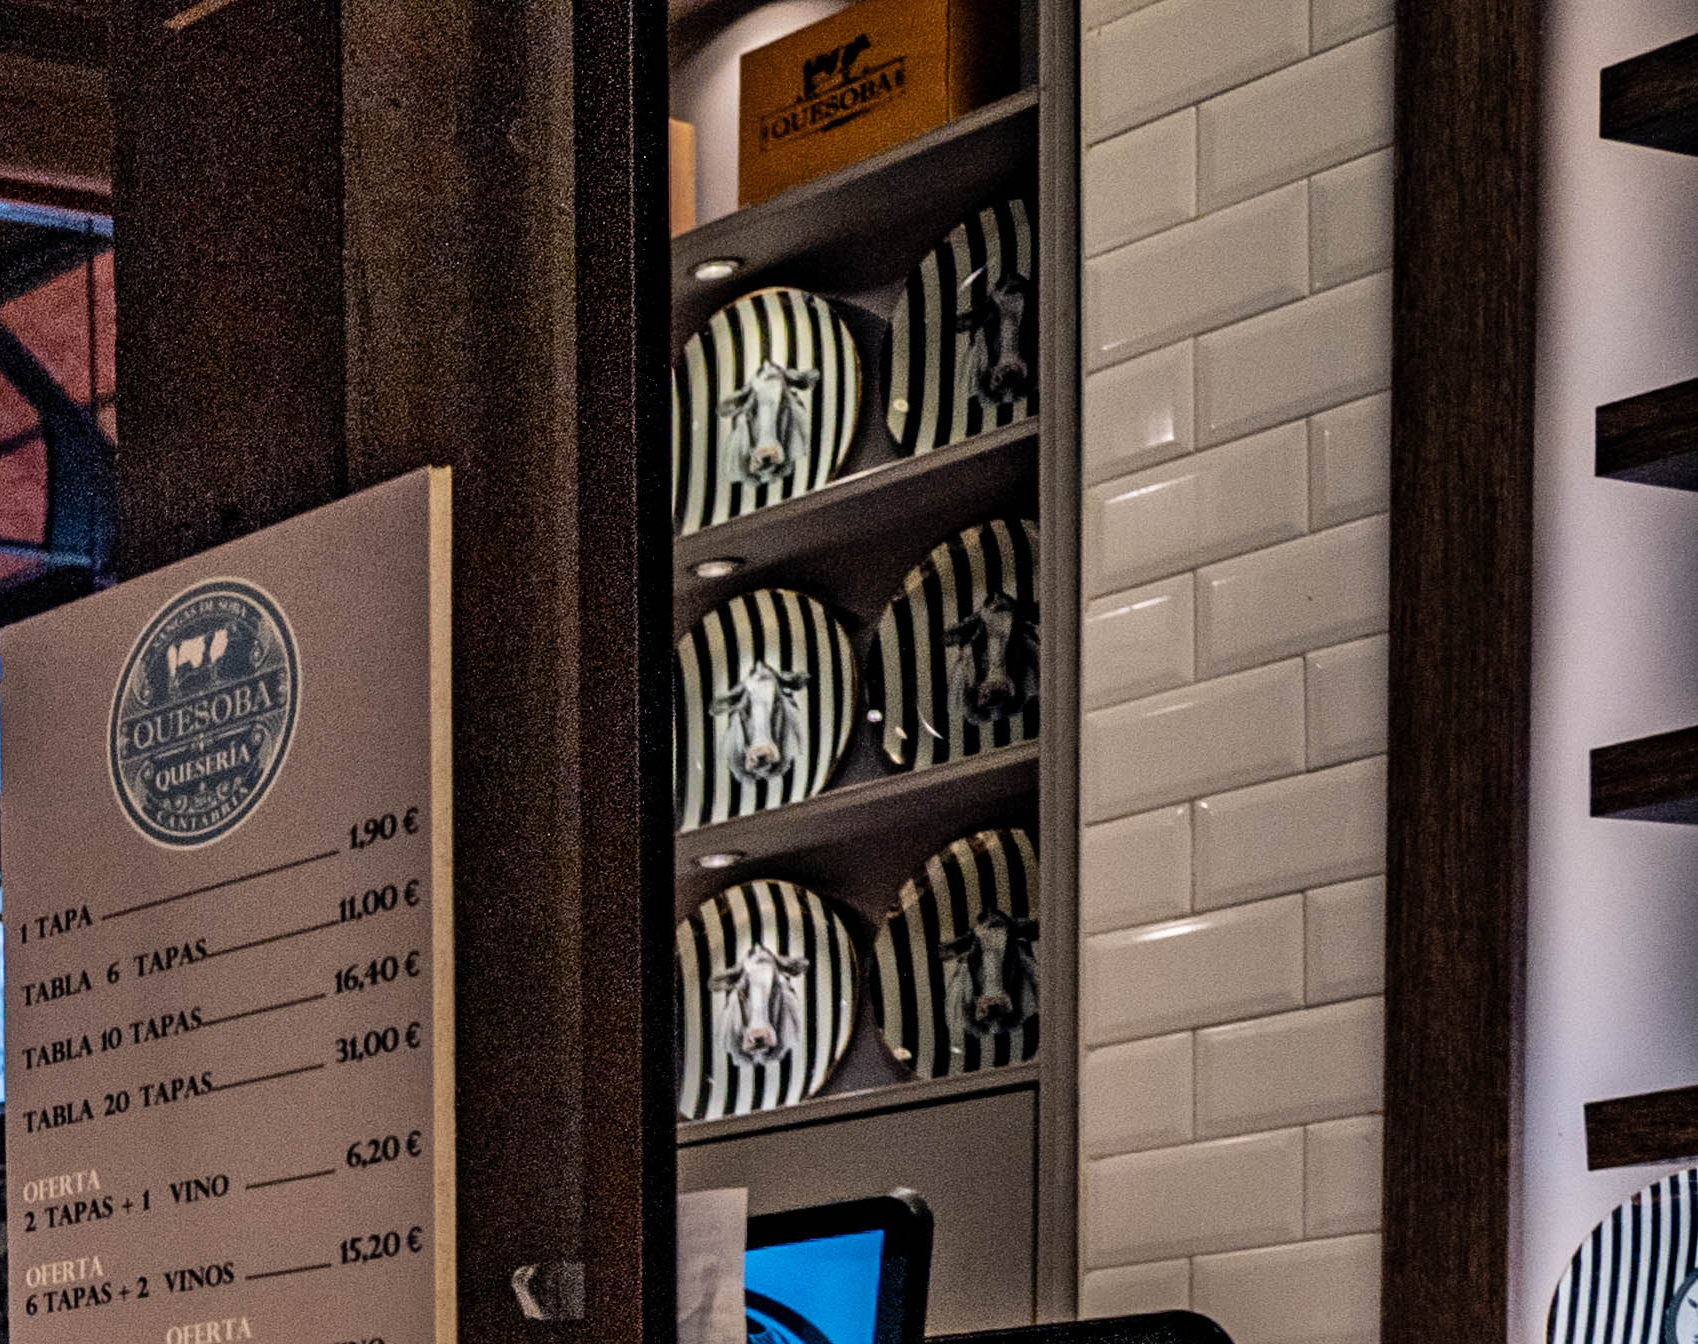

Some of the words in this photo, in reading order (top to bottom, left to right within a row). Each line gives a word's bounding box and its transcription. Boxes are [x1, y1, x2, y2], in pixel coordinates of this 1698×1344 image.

[133, 680, 272, 750] QUESOBA
[155, 740, 251, 791] QUESERÍA
[20, 925, 28, 943] 1
[34, 905, 93, 940] TAPA
[348, 814, 398, 850] 1,90
[402, 807, 420, 835] €
[22, 971, 91, 1006] TABLA
[107, 962, 120, 984] 6
[134, 939, 208, 978] TAPAS
[339, 885, 398, 923] 11,00
[403, 879, 420, 907] €
[22, 1035, 92, 1070] TABLA
[102, 1027, 122, 1052] 10
[129, 1007, 203, 1044] TAPAS
[335, 957, 398, 994] 16,40
[405, 951, 420, 978] €
[23, 1099, 94, 1134] TABLA
[103, 1091, 130, 1116] 20
[139, 1072, 214, 1108] TAPAS
[405, 1022, 421, 1050] €
[23, 1169, 102, 1202] OFERTA
[24, 1213, 37, 1233] 2
[44, 1195, 113, 1229] TAPAS
[122, 1198, 134, 1213] +
[142, 1190, 151, 1211] 1
[170, 1175, 229, 1204] VINO
[346, 1135, 400, 1169] 6,20
[407, 1130, 422, 1157] €
[26, 1295, 38, 1316] 6
[43, 1282, 112, 1314] TAPAS
[118, 1286, 130, 1302] +
[137, 1278, 149, 1299] 2
[164, 1262, 235, 1294] VINOS
[340, 1232, 400, 1266] 15,20
[408, 1226, 423, 1254] €
[26, 1255, 104, 1289] OFERTA
